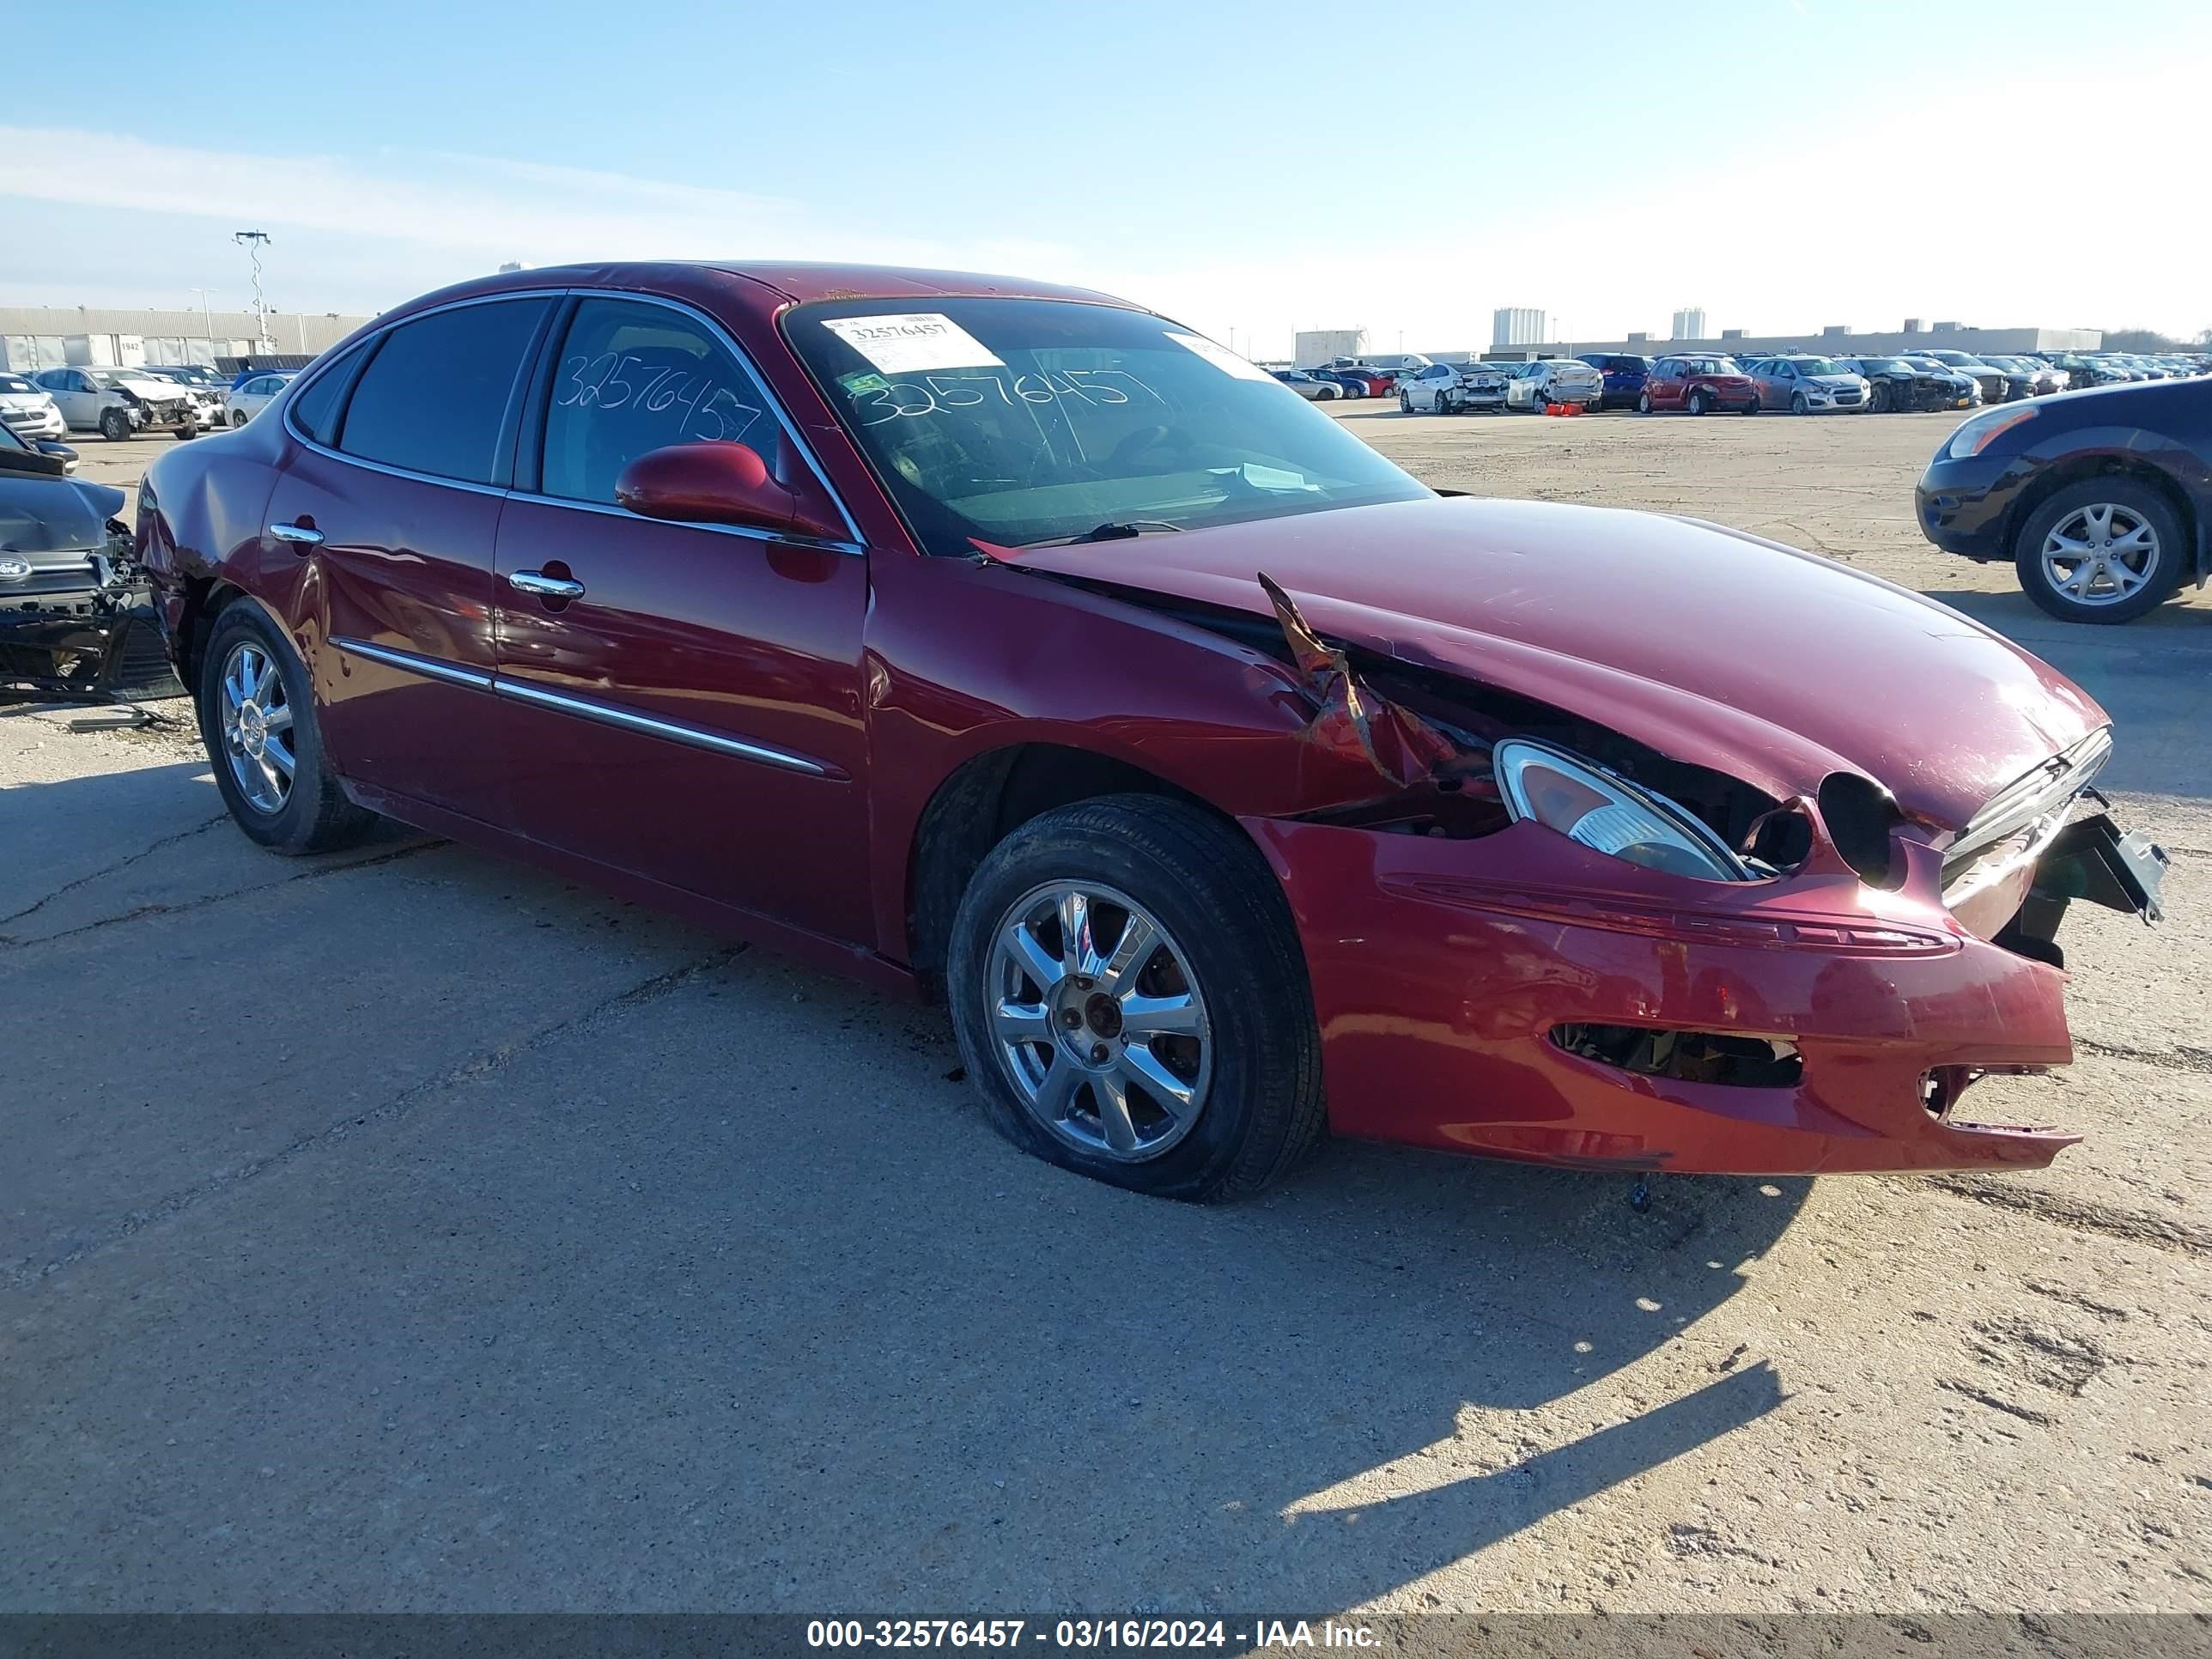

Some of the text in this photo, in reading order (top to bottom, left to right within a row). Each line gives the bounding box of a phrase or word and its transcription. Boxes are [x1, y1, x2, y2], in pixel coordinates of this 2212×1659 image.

[850, 324, 948, 340] 32576457
[557, 351, 763, 442] 32576457
[847, 370, 1166, 426] 32576457
